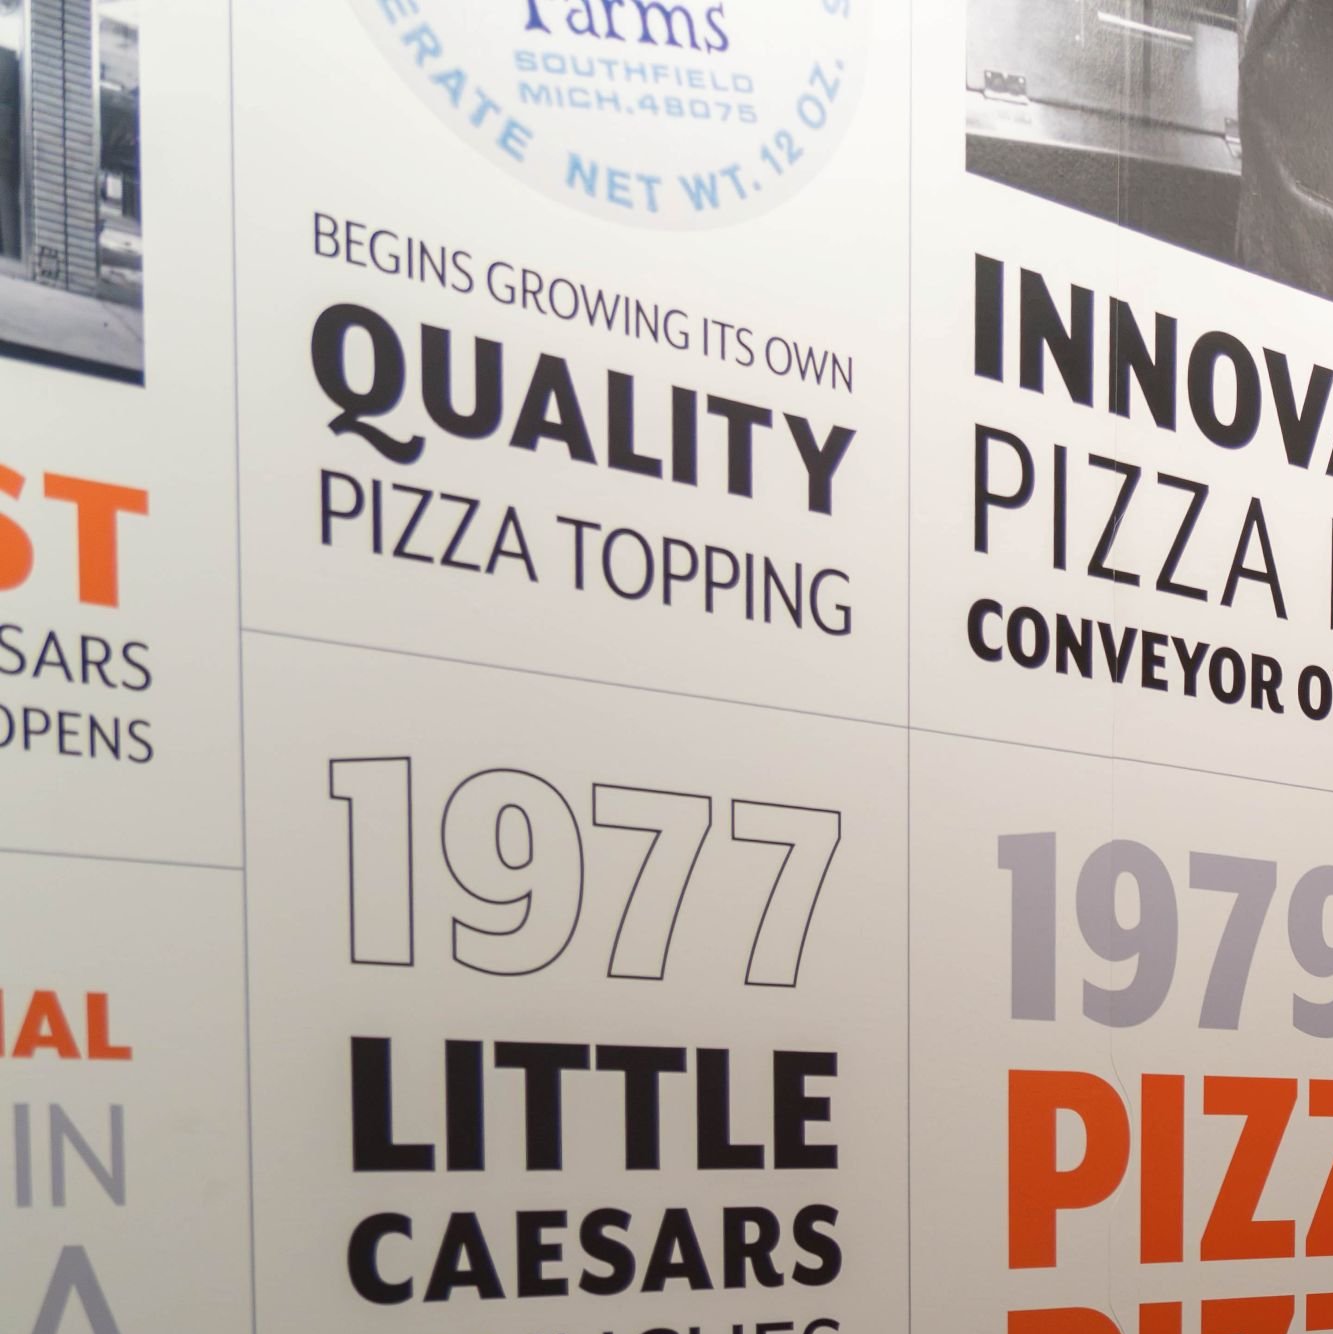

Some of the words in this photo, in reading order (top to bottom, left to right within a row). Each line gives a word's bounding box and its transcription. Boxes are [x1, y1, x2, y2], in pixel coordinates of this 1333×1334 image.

[514, 50, 755, 93] SOUTHFIELD
[518, 82, 758, 123] MICH.48075
[565, 154, 662, 212] NET
[313, 211, 475, 294] BEGINS
[487, 262, 689, 350] GROWING
[703, 316, 755, 367] ITS
[765, 337, 854, 393] OWN
[311, 303, 857, 517] QUALITY
[320, 469, 538, 584] PIZZA
[557, 515, 853, 637] TOPPING
[974, 423, 1289, 621] PIZZA
[967, 598, 1284, 714] CONVEYOR
[329, 756, 842, 987] 1977
[350, 1036, 838, 1172] LITTLE
[347, 1203, 843, 1305] CAESARS
